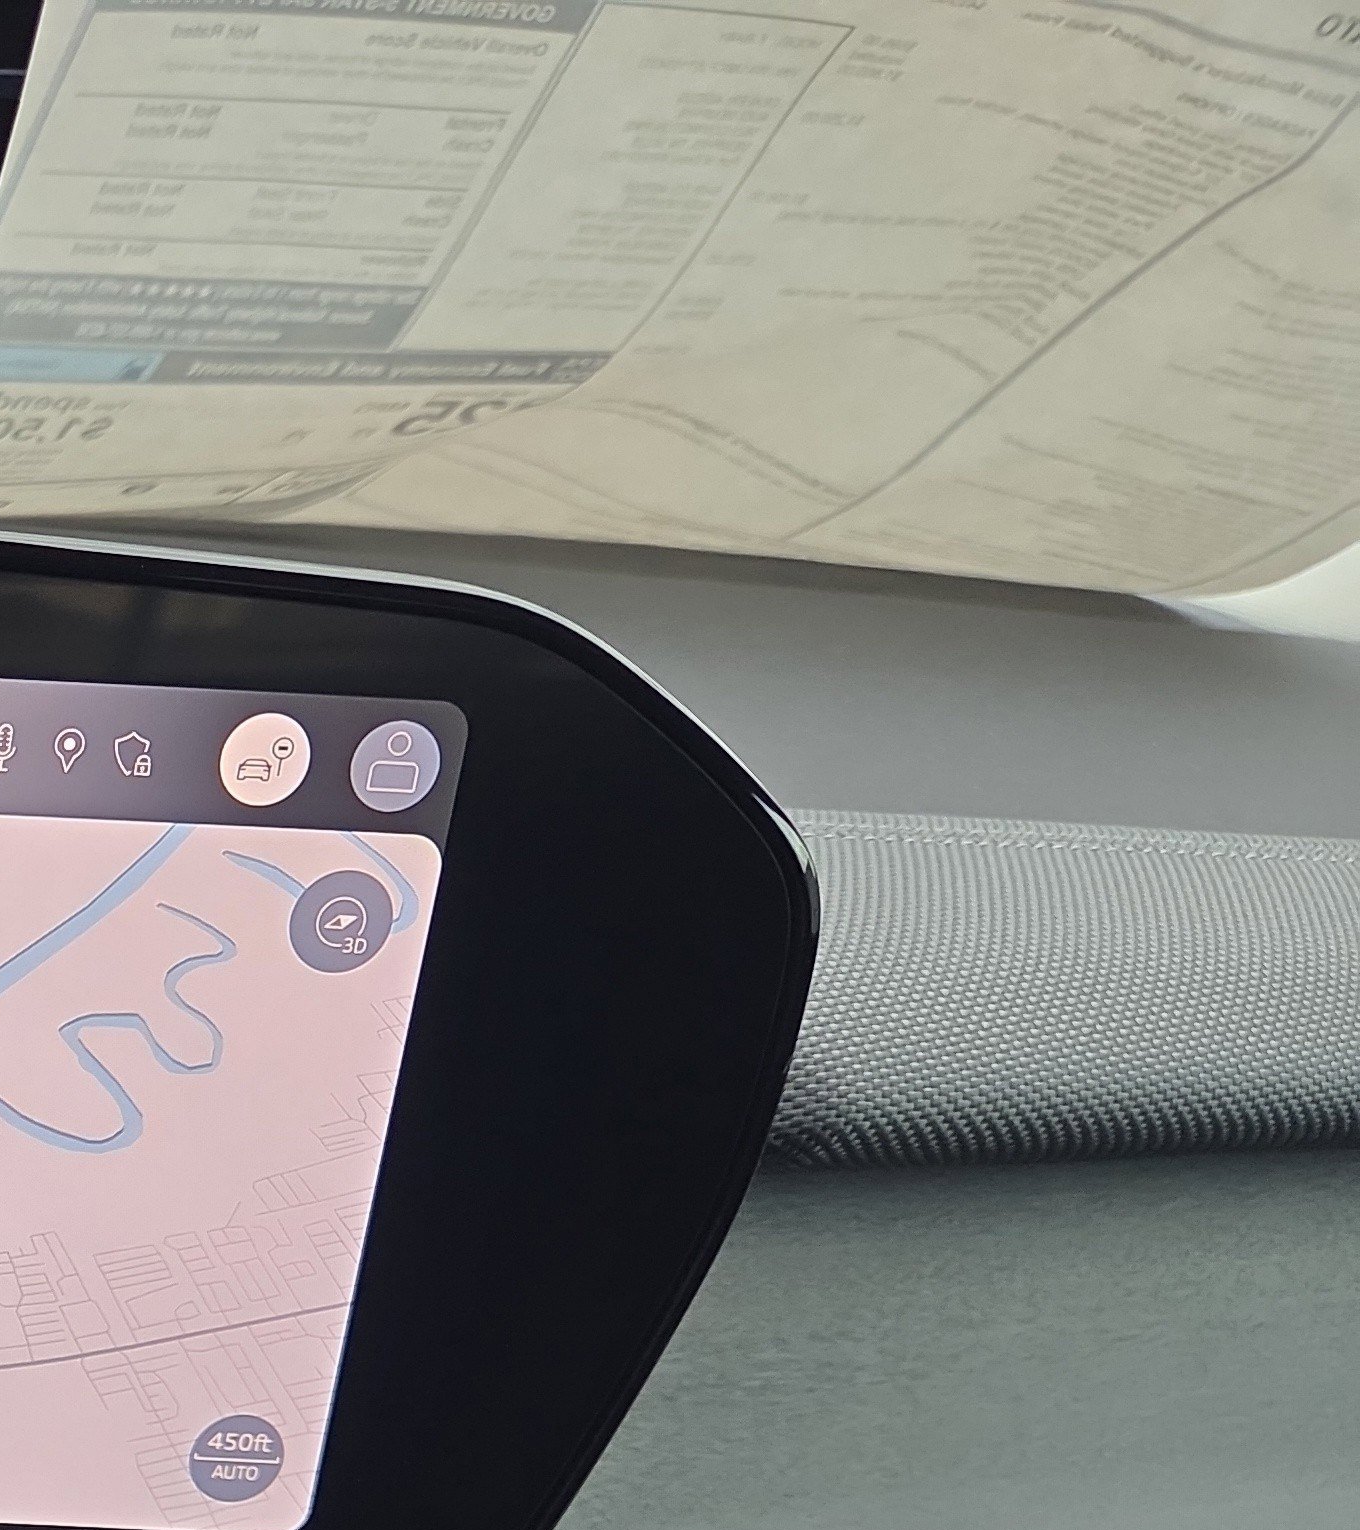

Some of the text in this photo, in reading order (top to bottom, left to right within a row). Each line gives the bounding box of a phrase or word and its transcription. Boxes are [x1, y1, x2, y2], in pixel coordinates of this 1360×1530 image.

[341, 936, 368, 956] 3D
[207, 1431, 274, 1454] 450ft
[210, 1462, 260, 1482] AUTO
